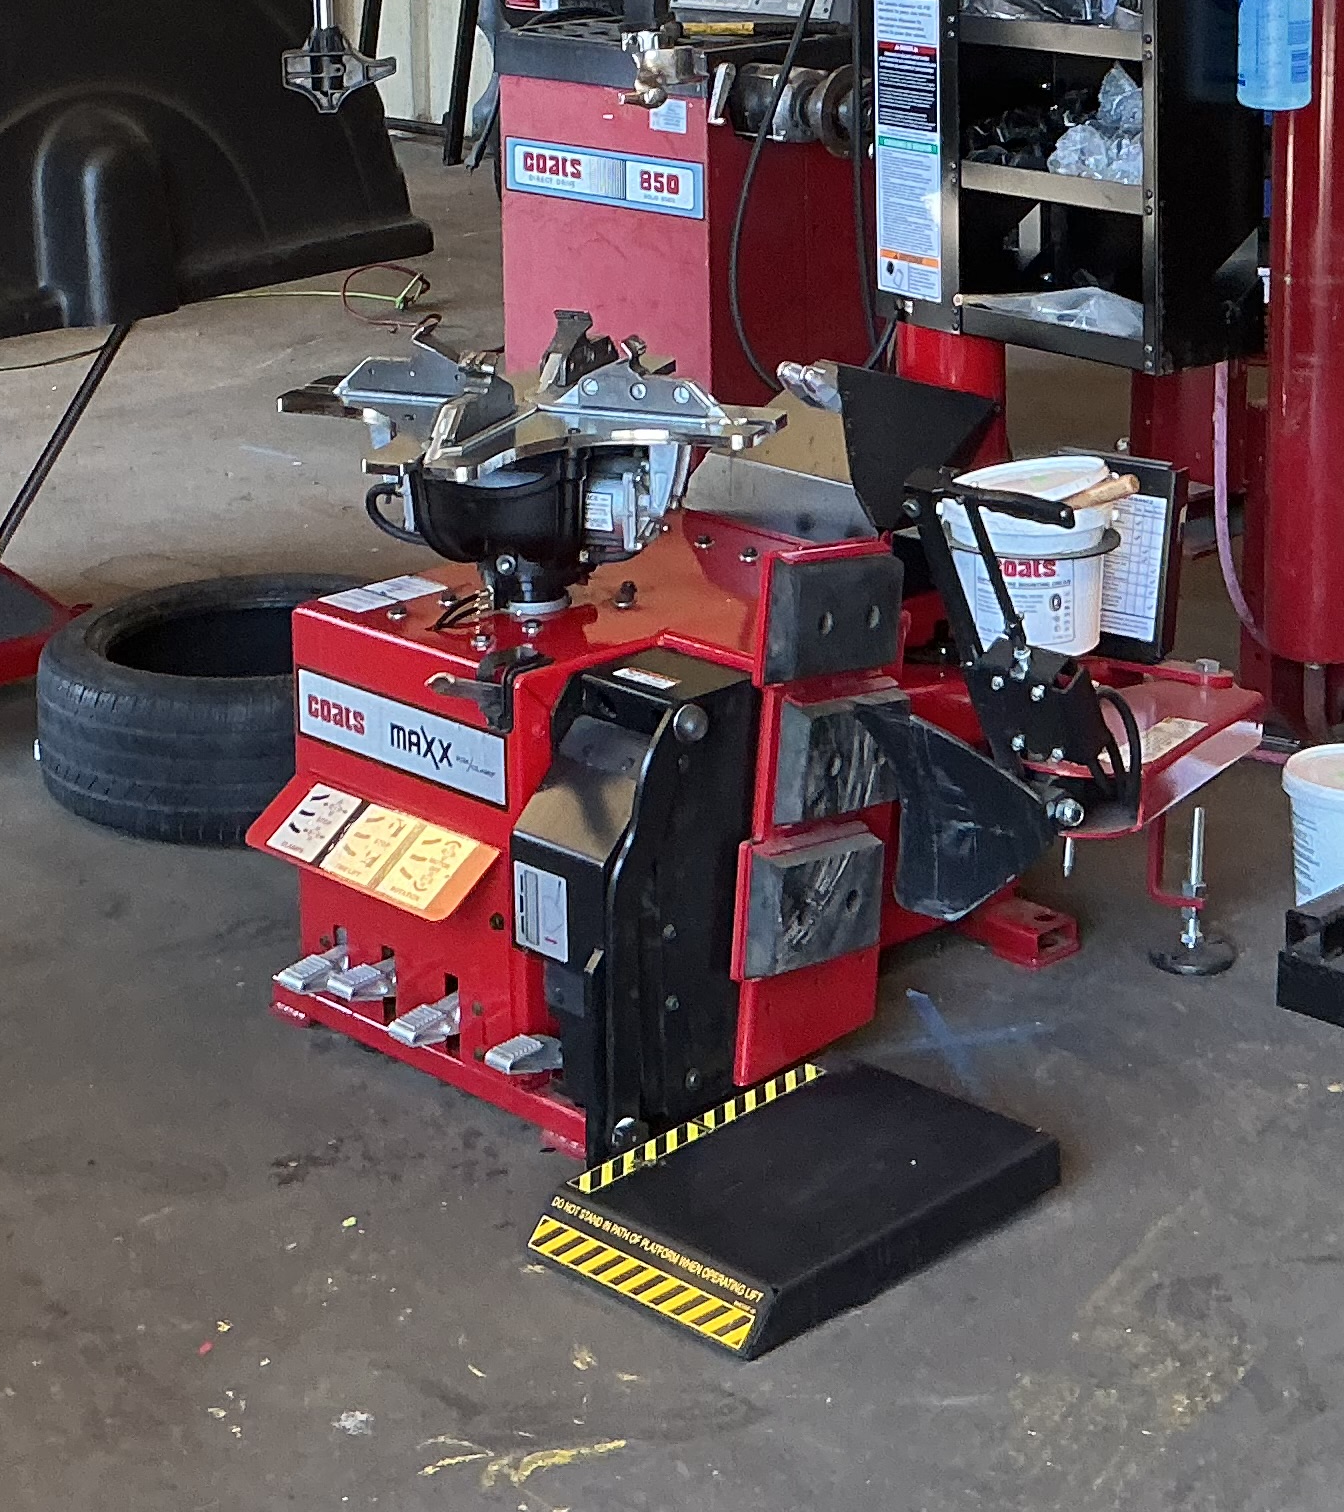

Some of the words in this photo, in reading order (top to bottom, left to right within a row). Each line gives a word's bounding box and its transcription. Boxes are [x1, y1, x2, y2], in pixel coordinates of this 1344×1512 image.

[639, 170, 680, 195] 850
[996, 559, 1056, 578] oats
[551, 1196, 565, 1209] DO
[563, 1201, 581, 1216] NOT
[578, 1209, 604, 1228] STAND
[601, 1220, 613, 1232] IN
[610, 1223, 632, 1241] PATH
[629, 1233, 643, 1245] OF
[639, 1238, 681, 1265] PLATFORM
[678, 1255, 704, 1275] WHEN
[701, 1267, 747, 1296] OPERATING
[744, 1288, 765, 1303] LIFT
